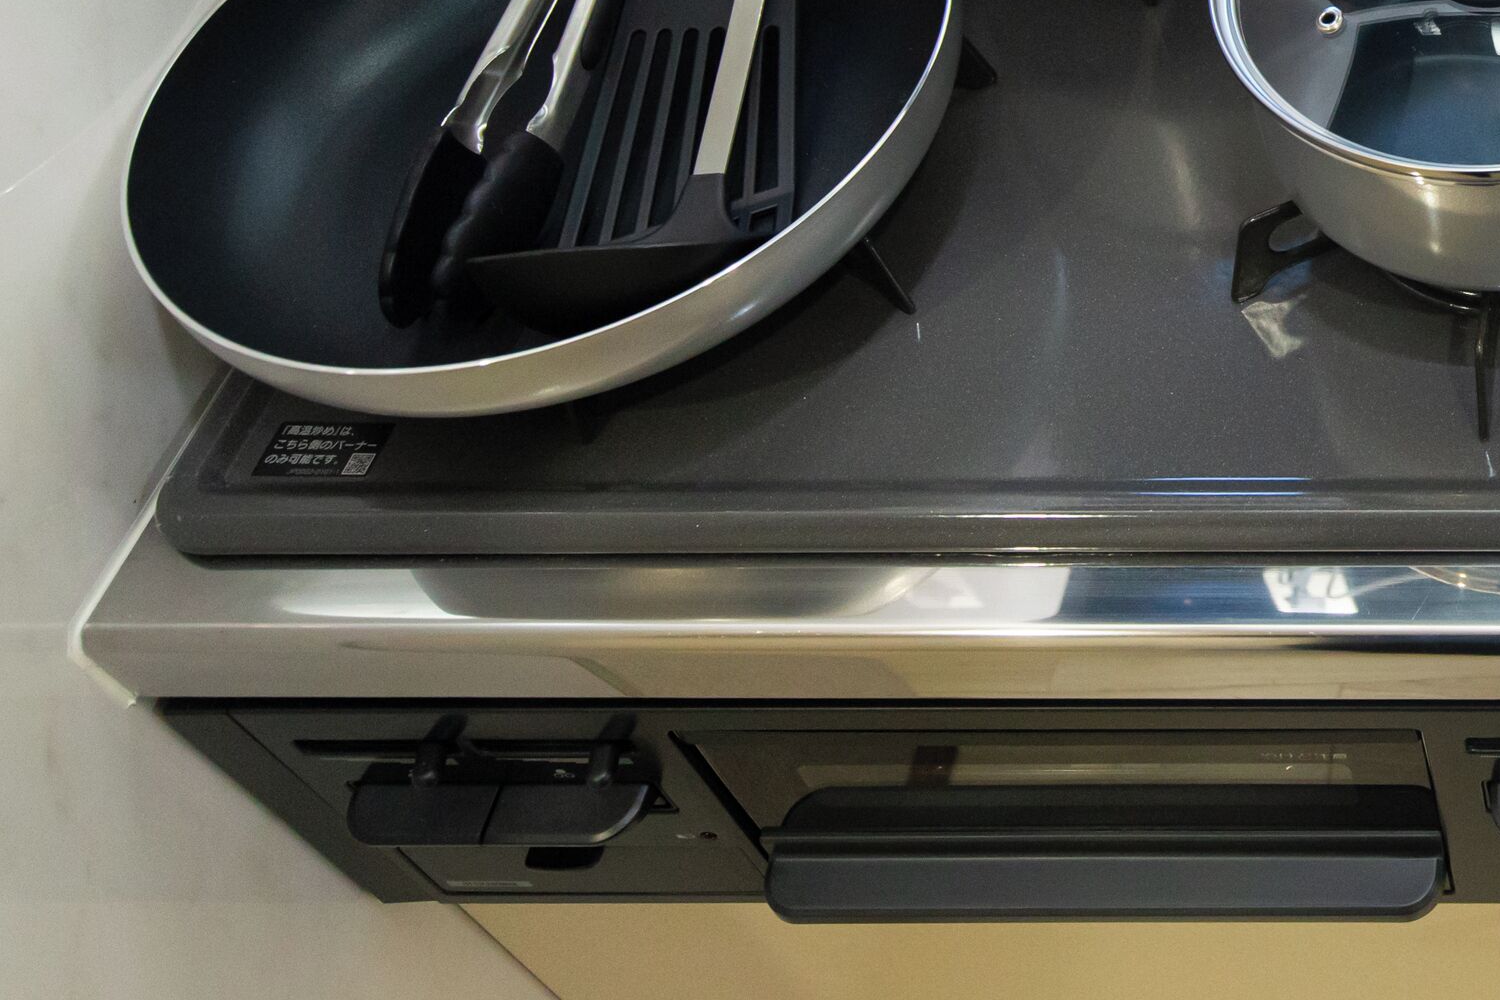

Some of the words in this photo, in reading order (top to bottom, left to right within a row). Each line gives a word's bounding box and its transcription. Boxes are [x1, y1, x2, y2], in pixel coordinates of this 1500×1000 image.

[273, 440, 377, 450] こちら側のバーナー
[264, 453, 339, 465] のみ可能です。
